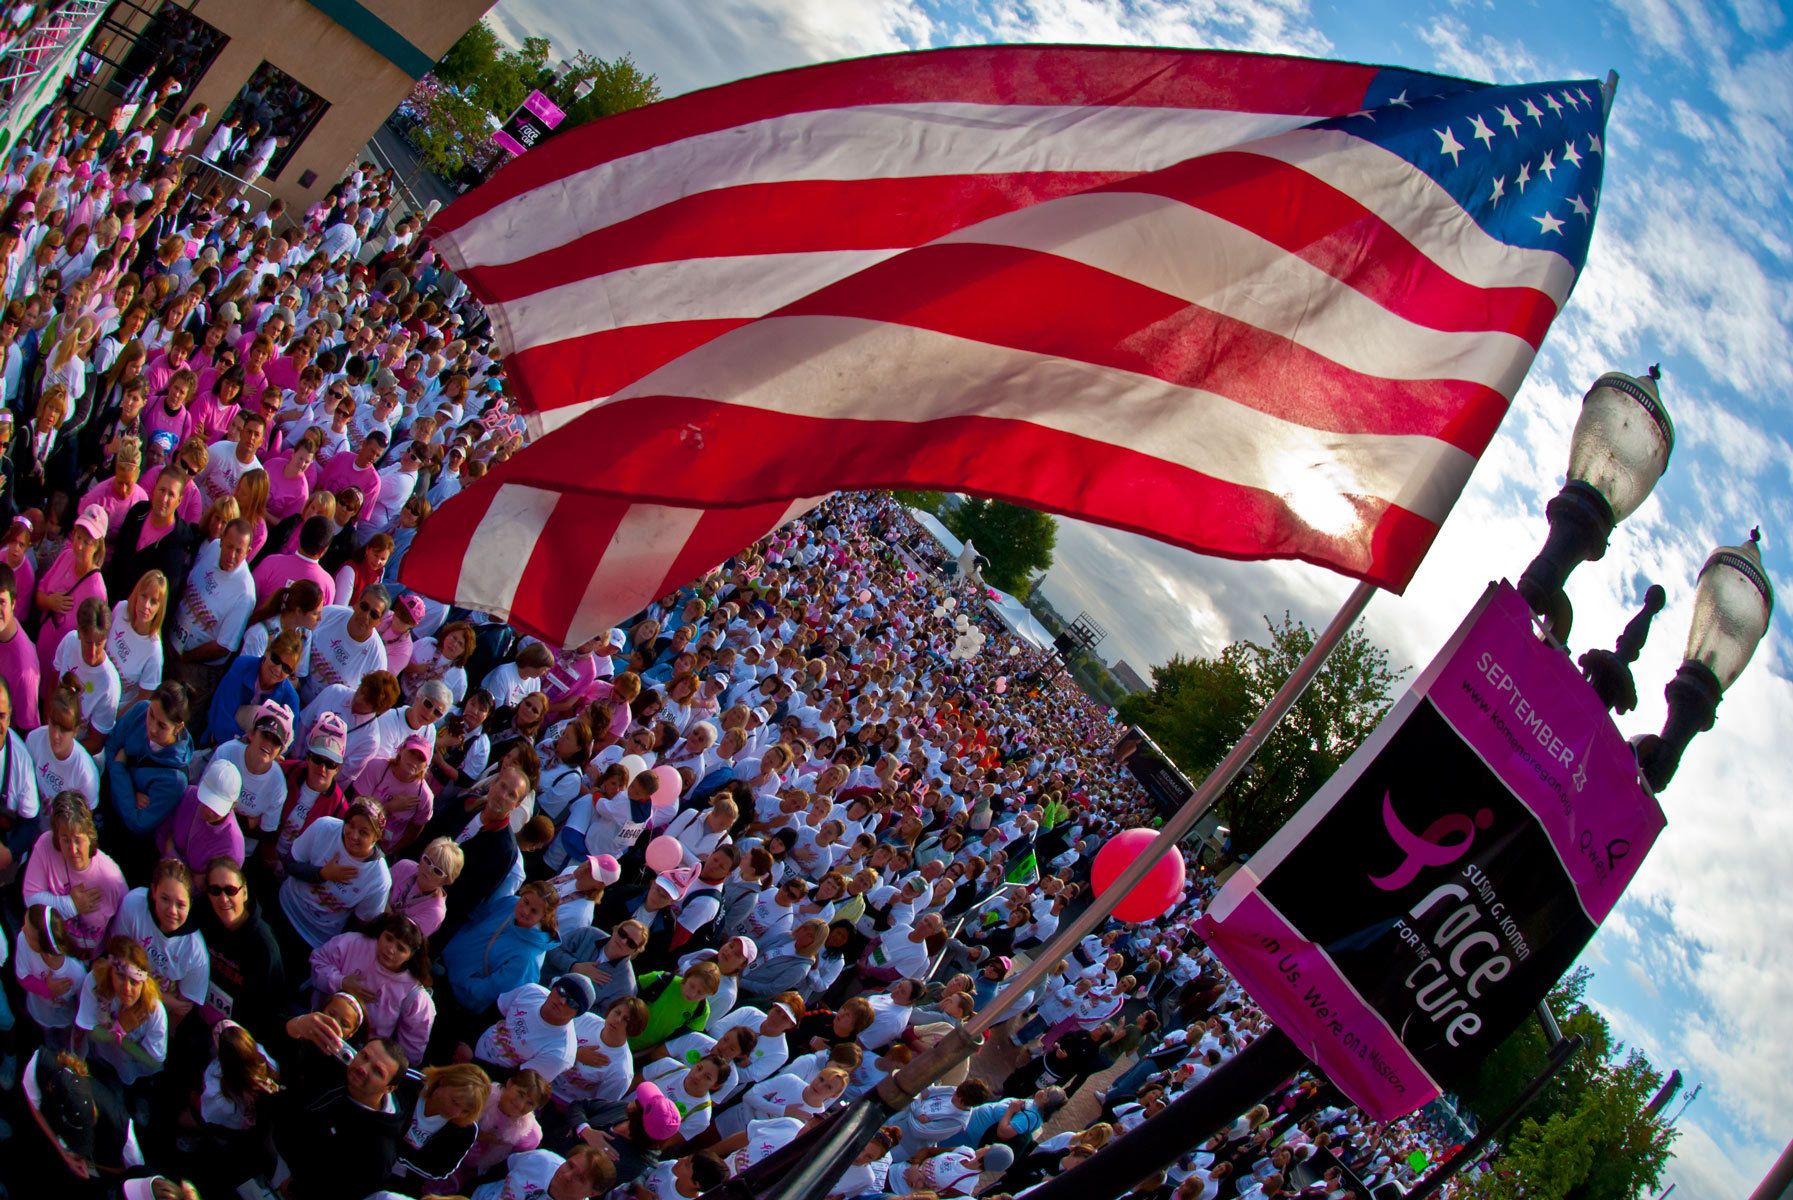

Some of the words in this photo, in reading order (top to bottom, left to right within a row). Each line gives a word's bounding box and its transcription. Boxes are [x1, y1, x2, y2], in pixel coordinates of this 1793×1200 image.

[1477, 652, 1575, 768] SEPTEMBER
[1572, 763, 1588, 792] 23
[241, 789, 256, 803] ace
[1392, 919, 1420, 948] FOR
[1415, 942, 1431, 961] THE
[1408, 883, 1512, 999] race
[1491, 902, 1505, 920] G.
[1279, 953, 1301, 988] Us.
[1304, 985, 1344, 1037] We're
[1343, 1032, 1361, 1052] on
[1359, 1044, 1368, 1059] a
[1404, 957, 1482, 1048] cure
